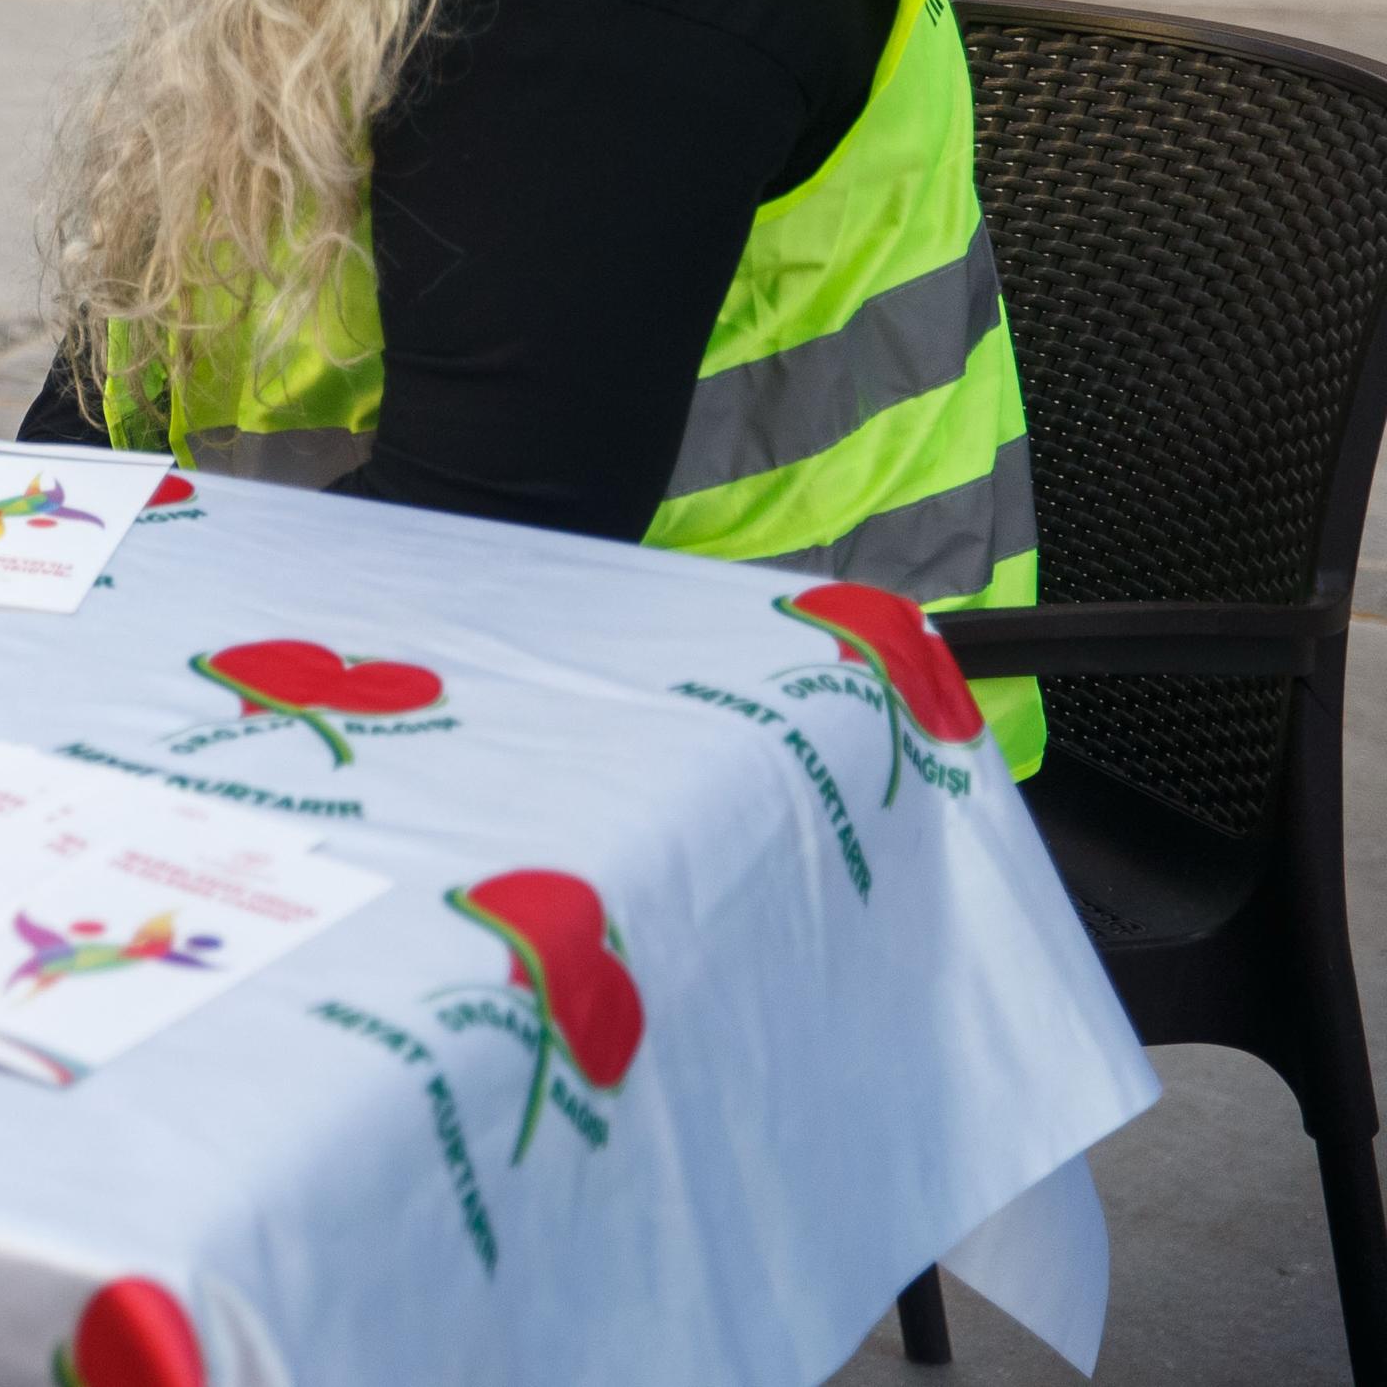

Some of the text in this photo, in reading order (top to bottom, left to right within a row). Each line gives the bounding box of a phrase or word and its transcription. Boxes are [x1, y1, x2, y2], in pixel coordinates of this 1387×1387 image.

[668, 680, 873, 907] HAYAT KURTARIR
[781, 672, 972, 800] ORGAN BAĞIŞI
